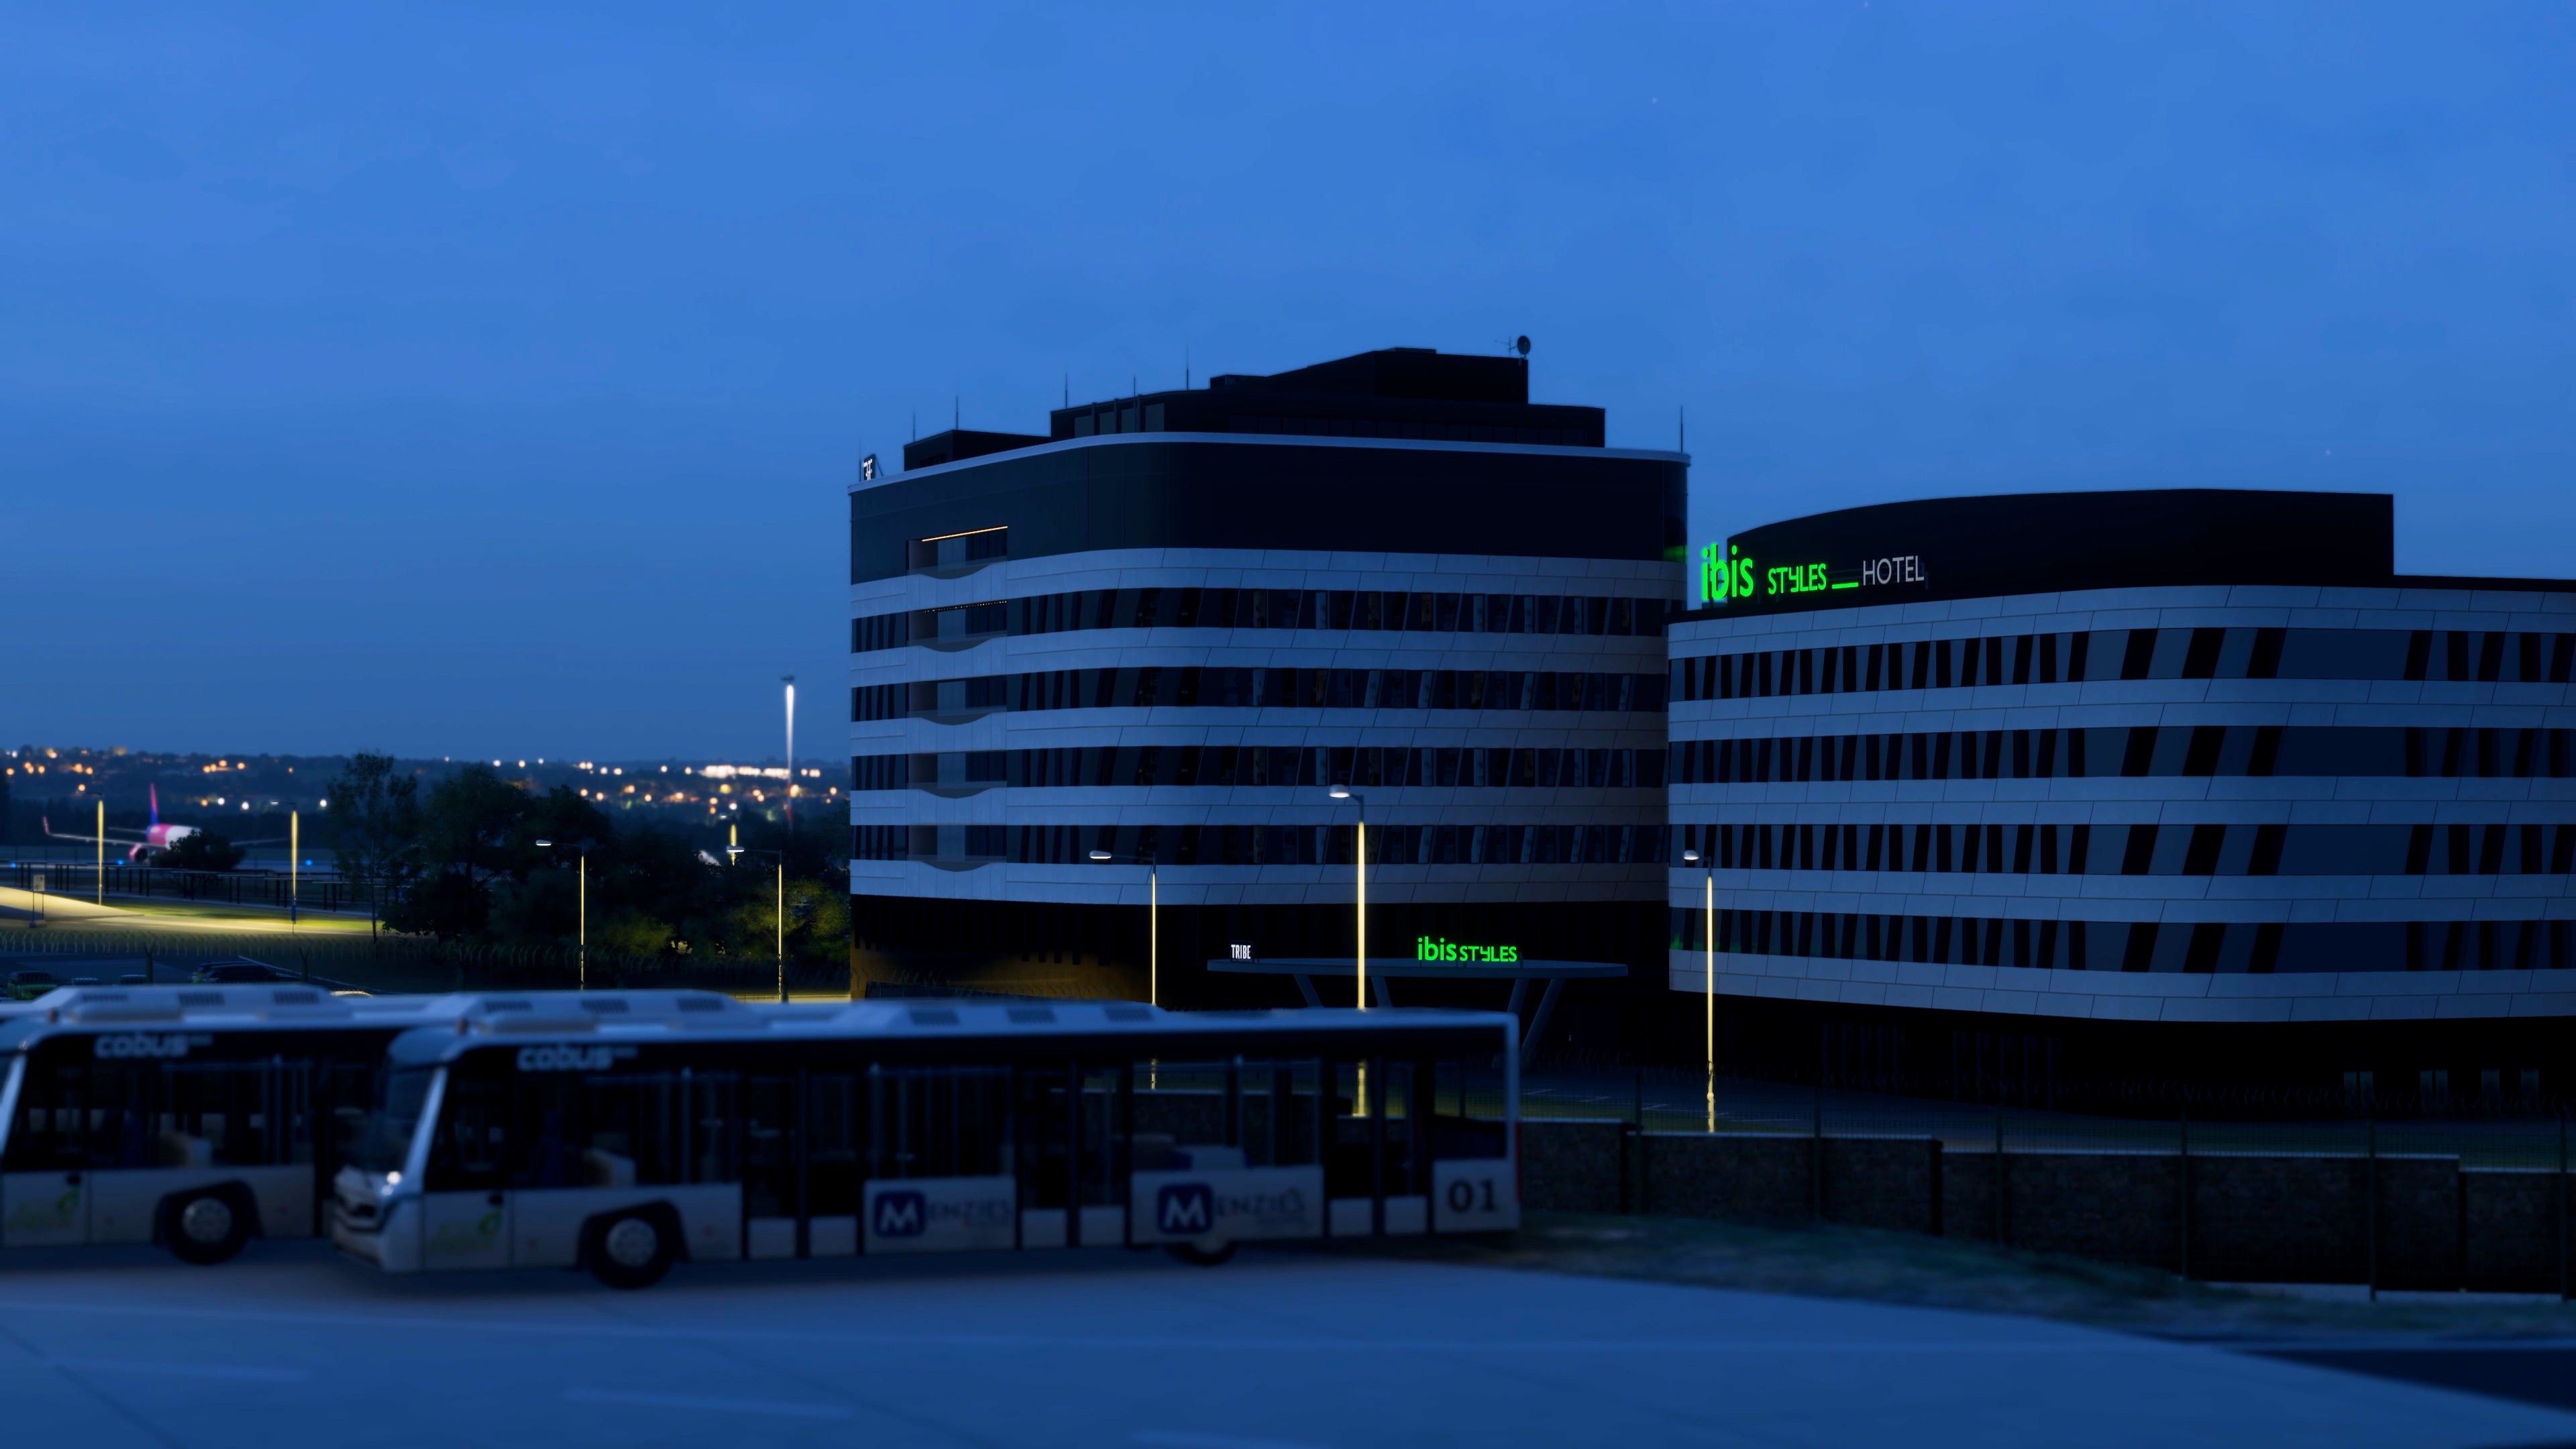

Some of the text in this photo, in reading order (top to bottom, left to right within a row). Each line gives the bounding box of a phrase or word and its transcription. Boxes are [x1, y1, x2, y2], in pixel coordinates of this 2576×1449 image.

[1701, 544, 1925, 601] ibis STYLES HOTEL
[1230, 944, 1251, 959] TRIBE
[1417, 936, 1517, 962] ibis STYLES
[1448, 1177, 1499, 1214] 01
